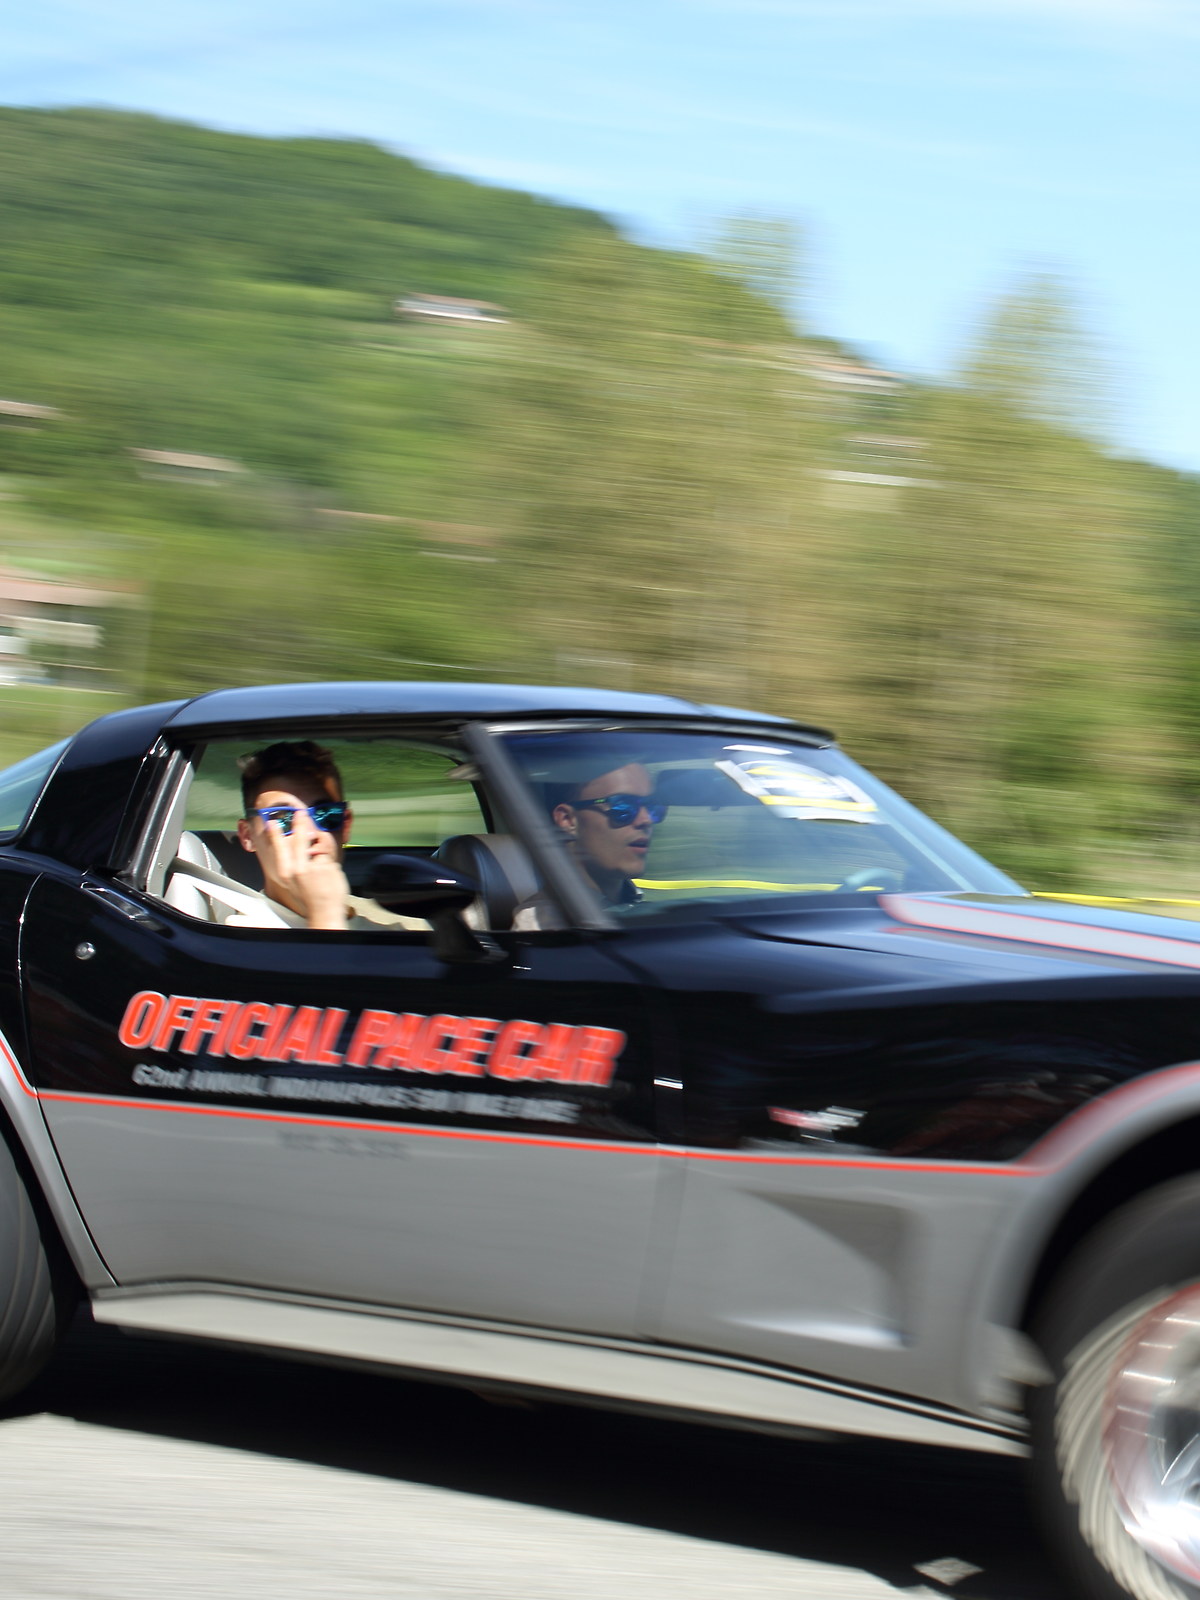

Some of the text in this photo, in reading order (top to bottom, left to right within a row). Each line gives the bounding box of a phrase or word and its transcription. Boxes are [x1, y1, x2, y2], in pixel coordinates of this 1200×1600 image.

[118, 990, 627, 1088] OFFICIAL PACE CAR
